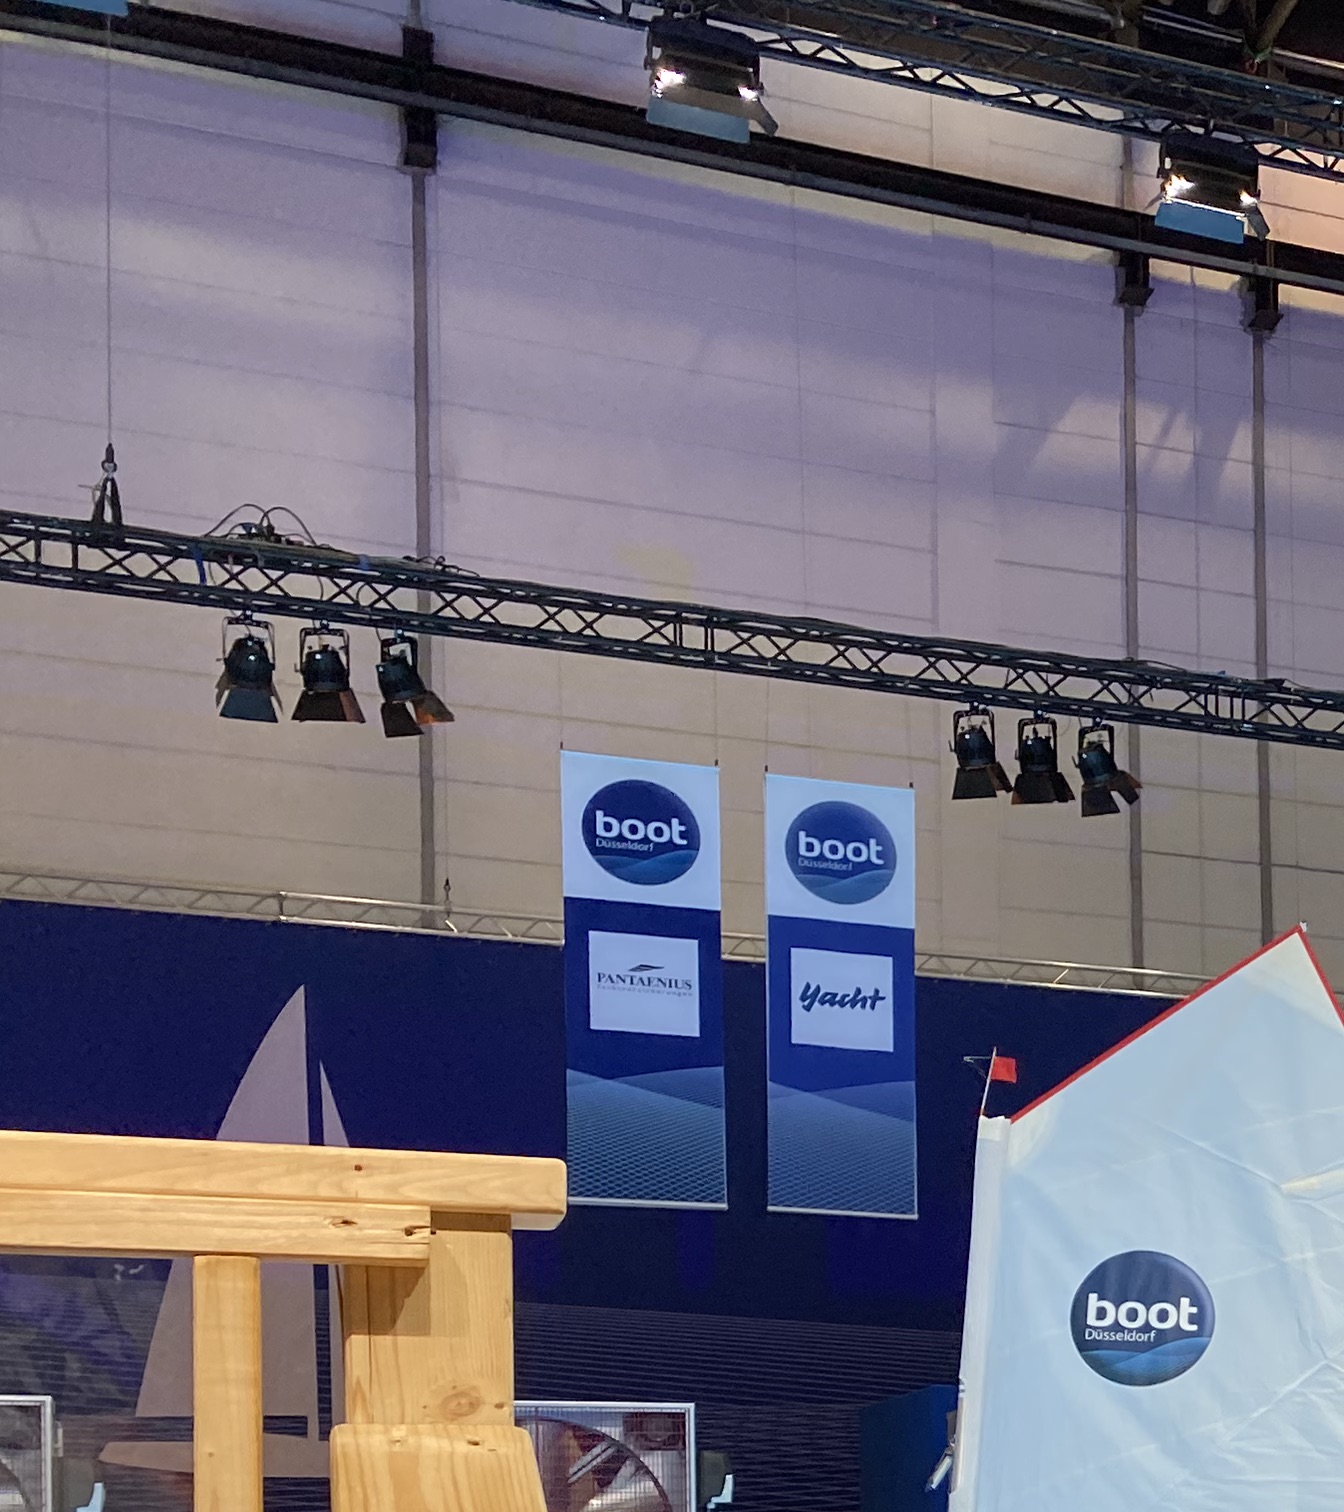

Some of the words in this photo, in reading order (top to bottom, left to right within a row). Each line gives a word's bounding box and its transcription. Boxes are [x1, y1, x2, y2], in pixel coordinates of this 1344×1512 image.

[596, 810, 688, 845] boot
[596, 837, 654, 852] Düsseldorf
[798, 831, 884, 865] boot
[597, 972, 692, 990] PANTAENIUS
[799, 981, 886, 1013] Yacht
[1086, 1293, 1198, 1332] boot
[1085, 1328, 1156, 1343] Düsseldorf
